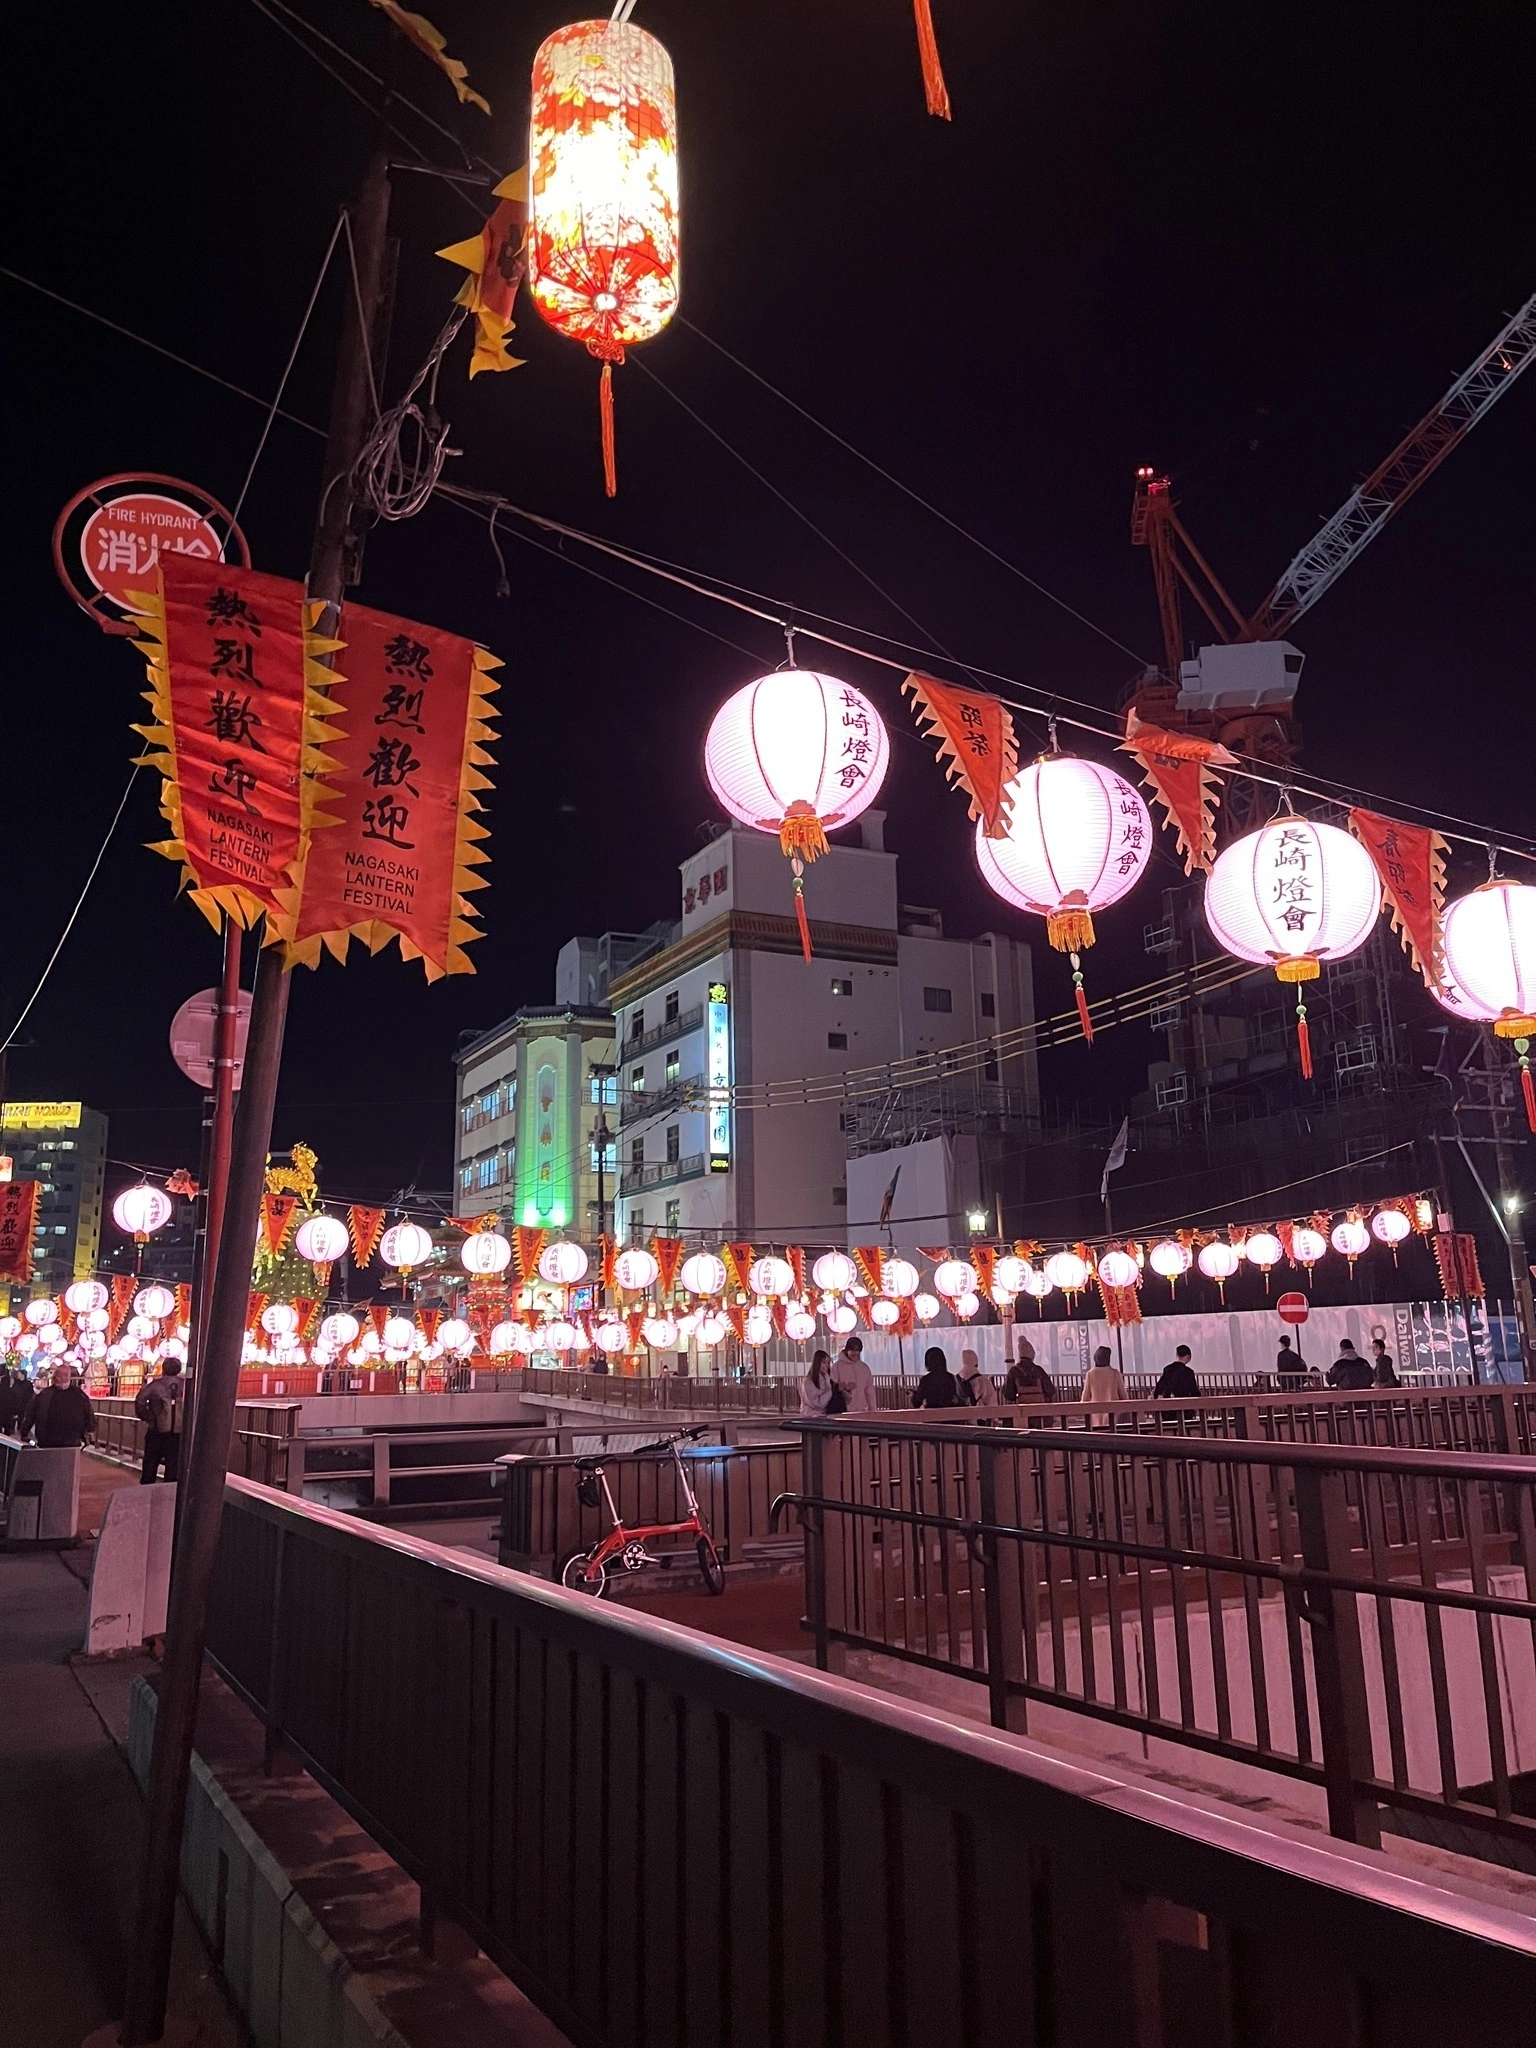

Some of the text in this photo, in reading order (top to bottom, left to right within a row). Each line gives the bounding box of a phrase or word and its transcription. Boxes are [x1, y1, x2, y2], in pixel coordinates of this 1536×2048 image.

[108, 507, 199, 530] FIRE HYDRANT
[203, 586, 268, 818] 熱烈歡迎
[362, 633, 434, 850] 熱烈歡迎
[834, 688, 873, 788] 長崎燈會
[207, 807, 274, 846] NAGASAKI
[209, 828, 270, 864] LANTERN
[1113, 778, 1145, 875] 長崎燈會
[209, 847, 265, 884] FESTIVAL
[344, 851, 420, 881] NAGASAKI
[345, 870, 415, 897] LANTERN
[1272, 828, 1318, 932] 長崎燈會
[343, 889, 413, 915] FESTIVAL
[1079, 1325, 1088, 1370] Daiwa
[1396, 1309, 1411, 1367] Daiwa
